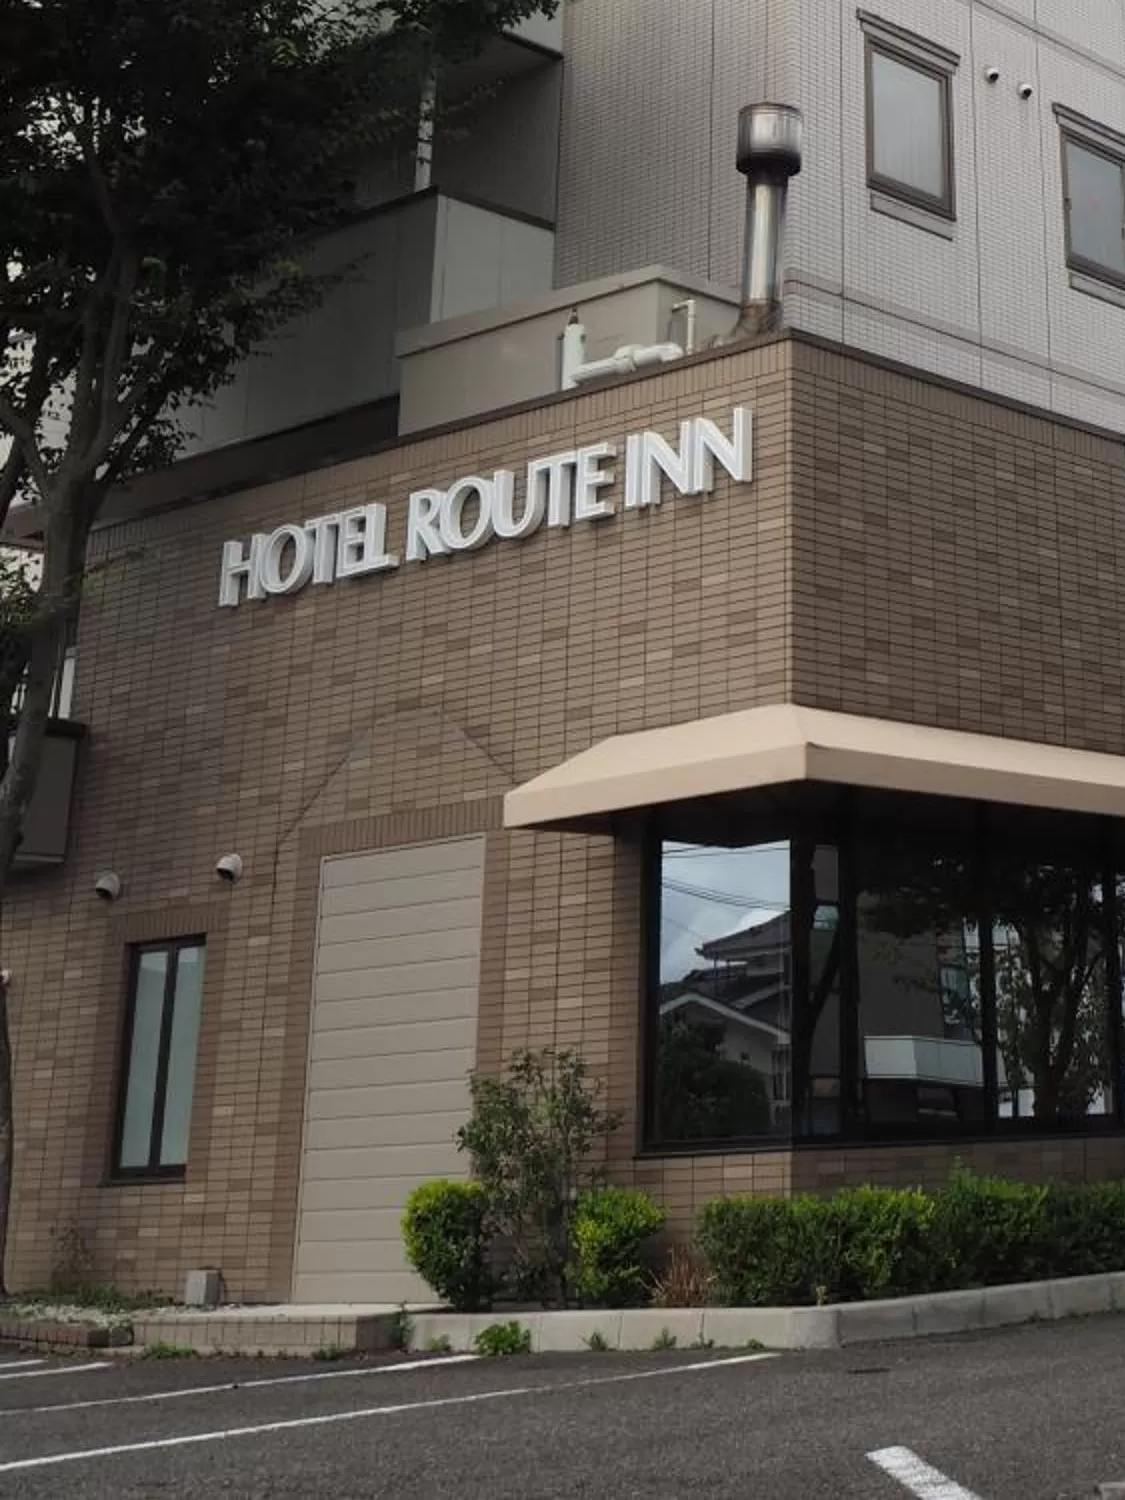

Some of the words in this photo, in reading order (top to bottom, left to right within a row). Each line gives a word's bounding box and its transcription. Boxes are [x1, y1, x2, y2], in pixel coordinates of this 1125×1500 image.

[219, 502, 399, 606] HOTEL
[405, 442, 616, 561] ROUTE
[625, 407, 753, 510] INN
